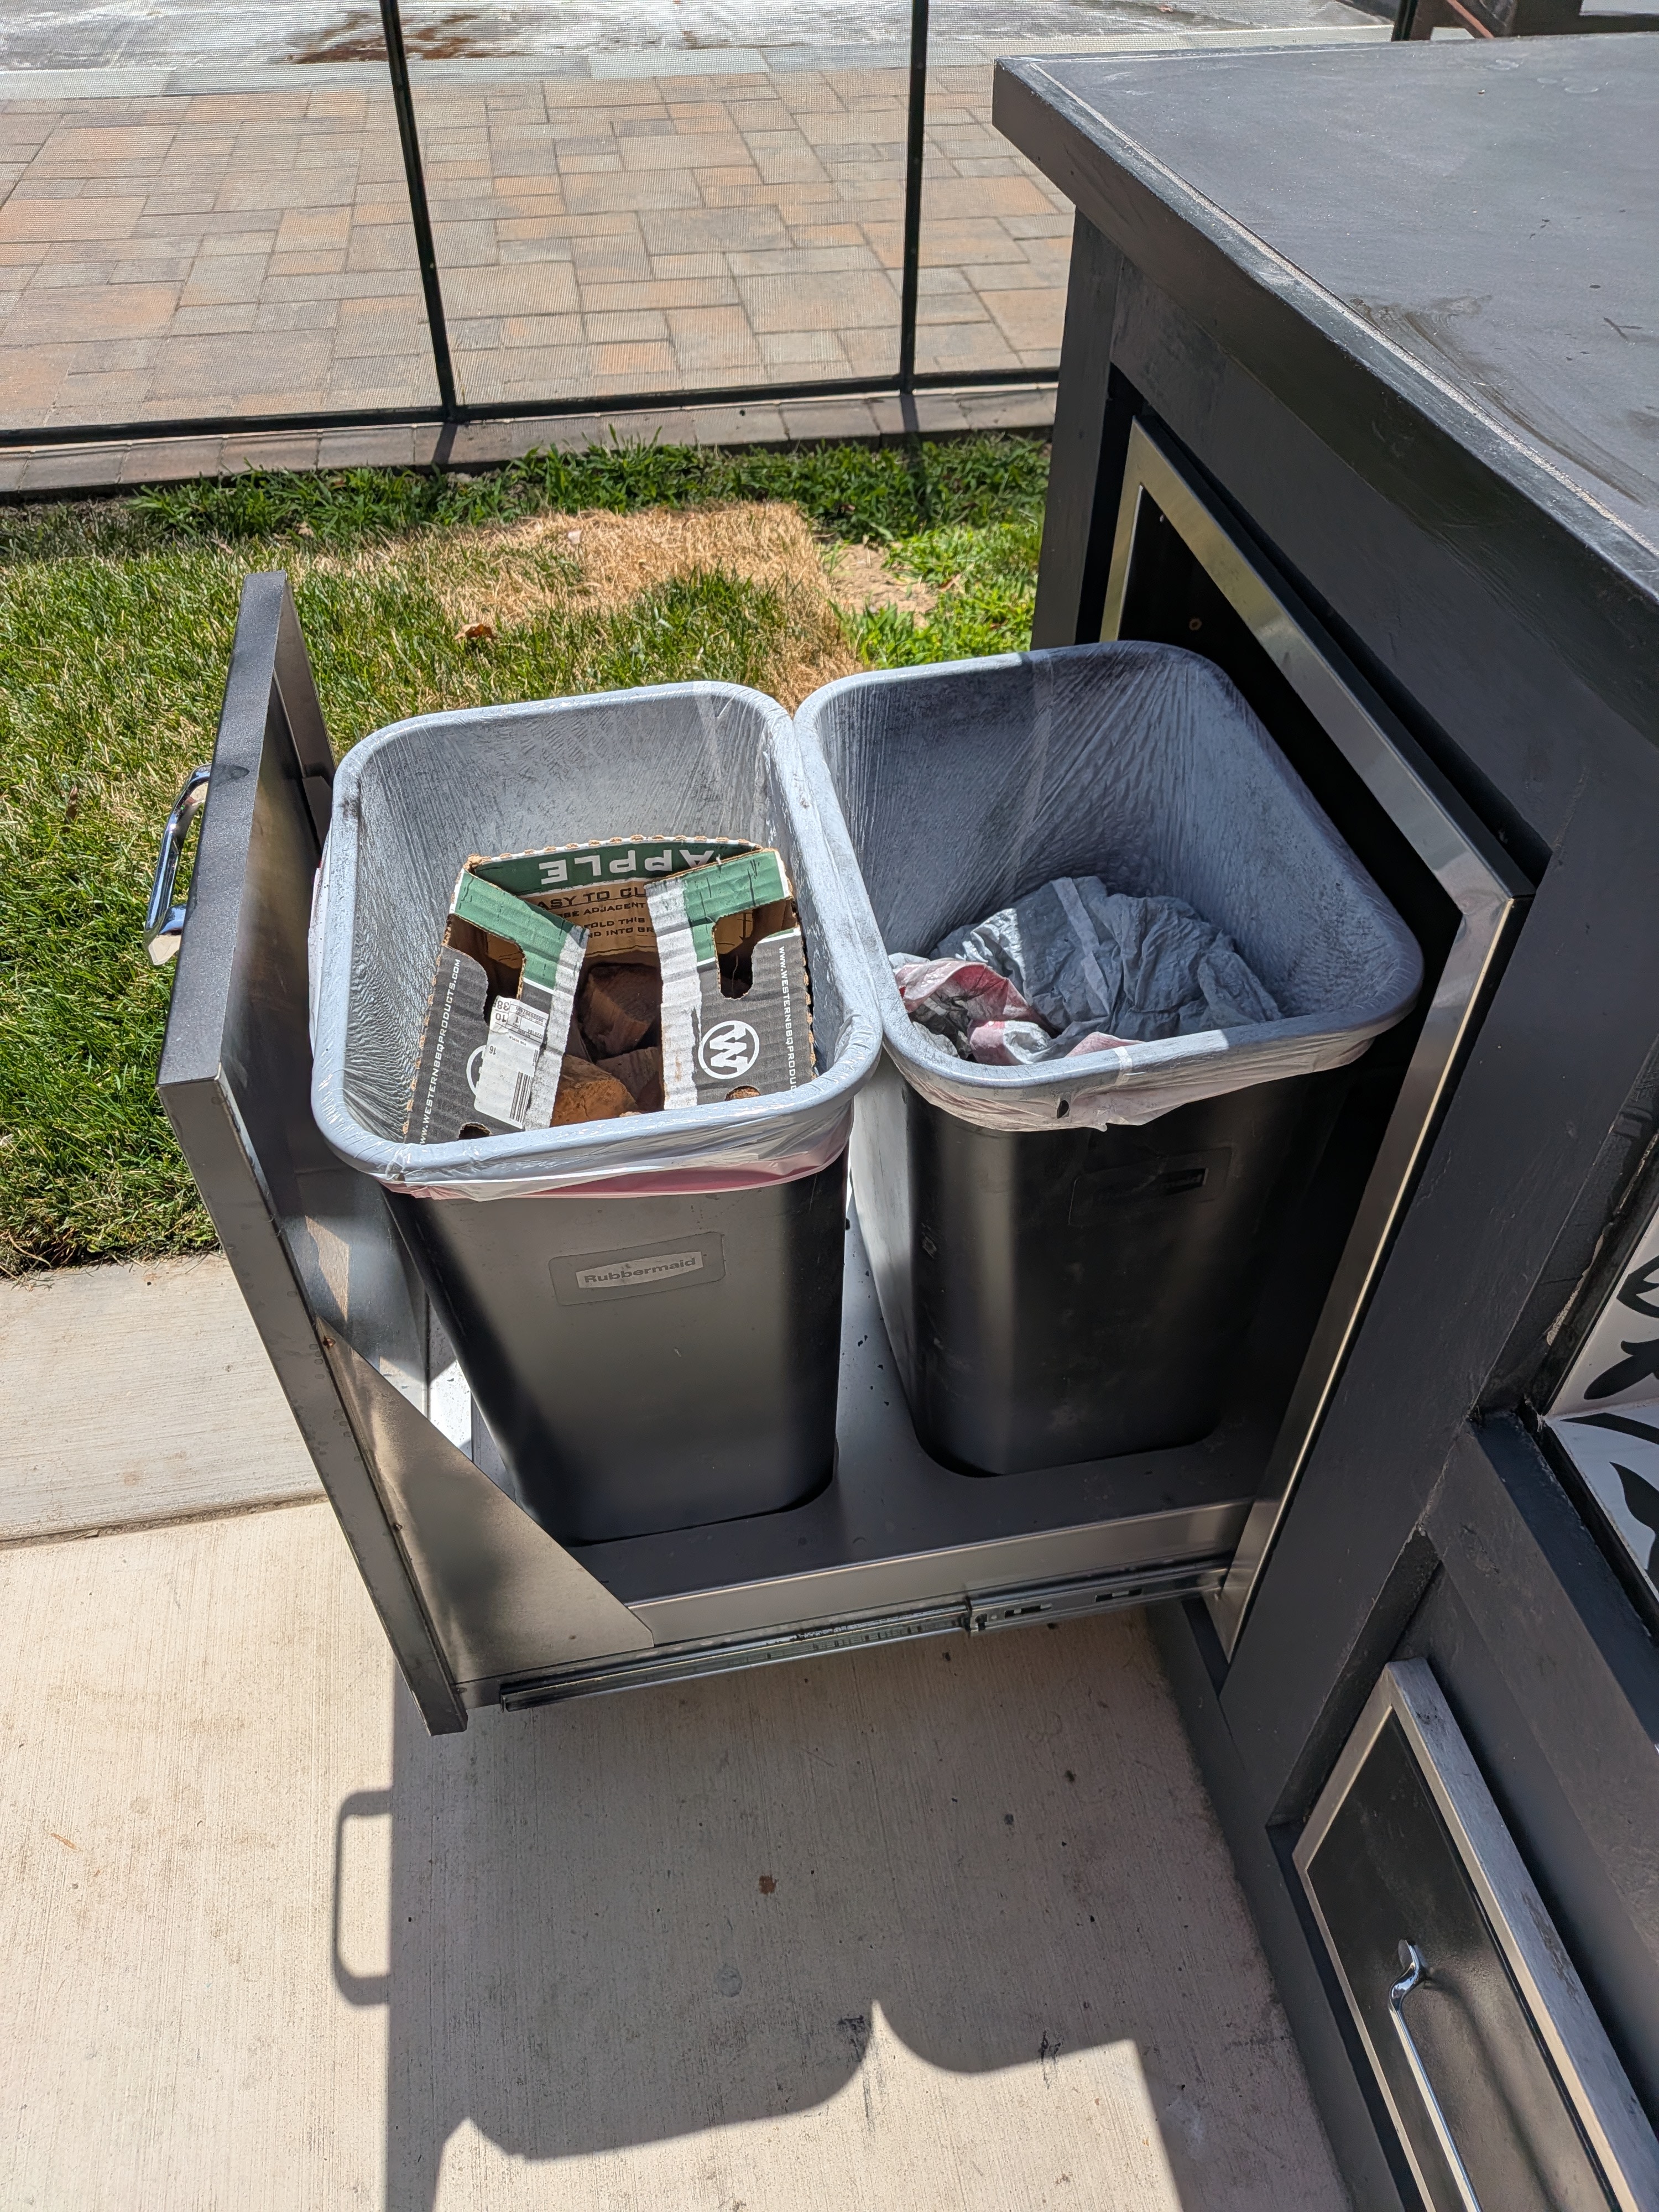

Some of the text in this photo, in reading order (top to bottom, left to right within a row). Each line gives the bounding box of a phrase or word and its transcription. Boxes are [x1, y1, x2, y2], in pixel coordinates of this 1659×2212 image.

[539, 849, 714, 885] APPLE
[582, 891, 610, 902] TO
[583, 902, 645, 915] ADJACENT
[606, 927, 633, 936] INTO
[495, 1013, 507, 1022] 10
[489, 1045, 496, 1055] 16
[707, 1021, 752, 1076] W
[585, 1256, 696, 1283] Rubbermaid
